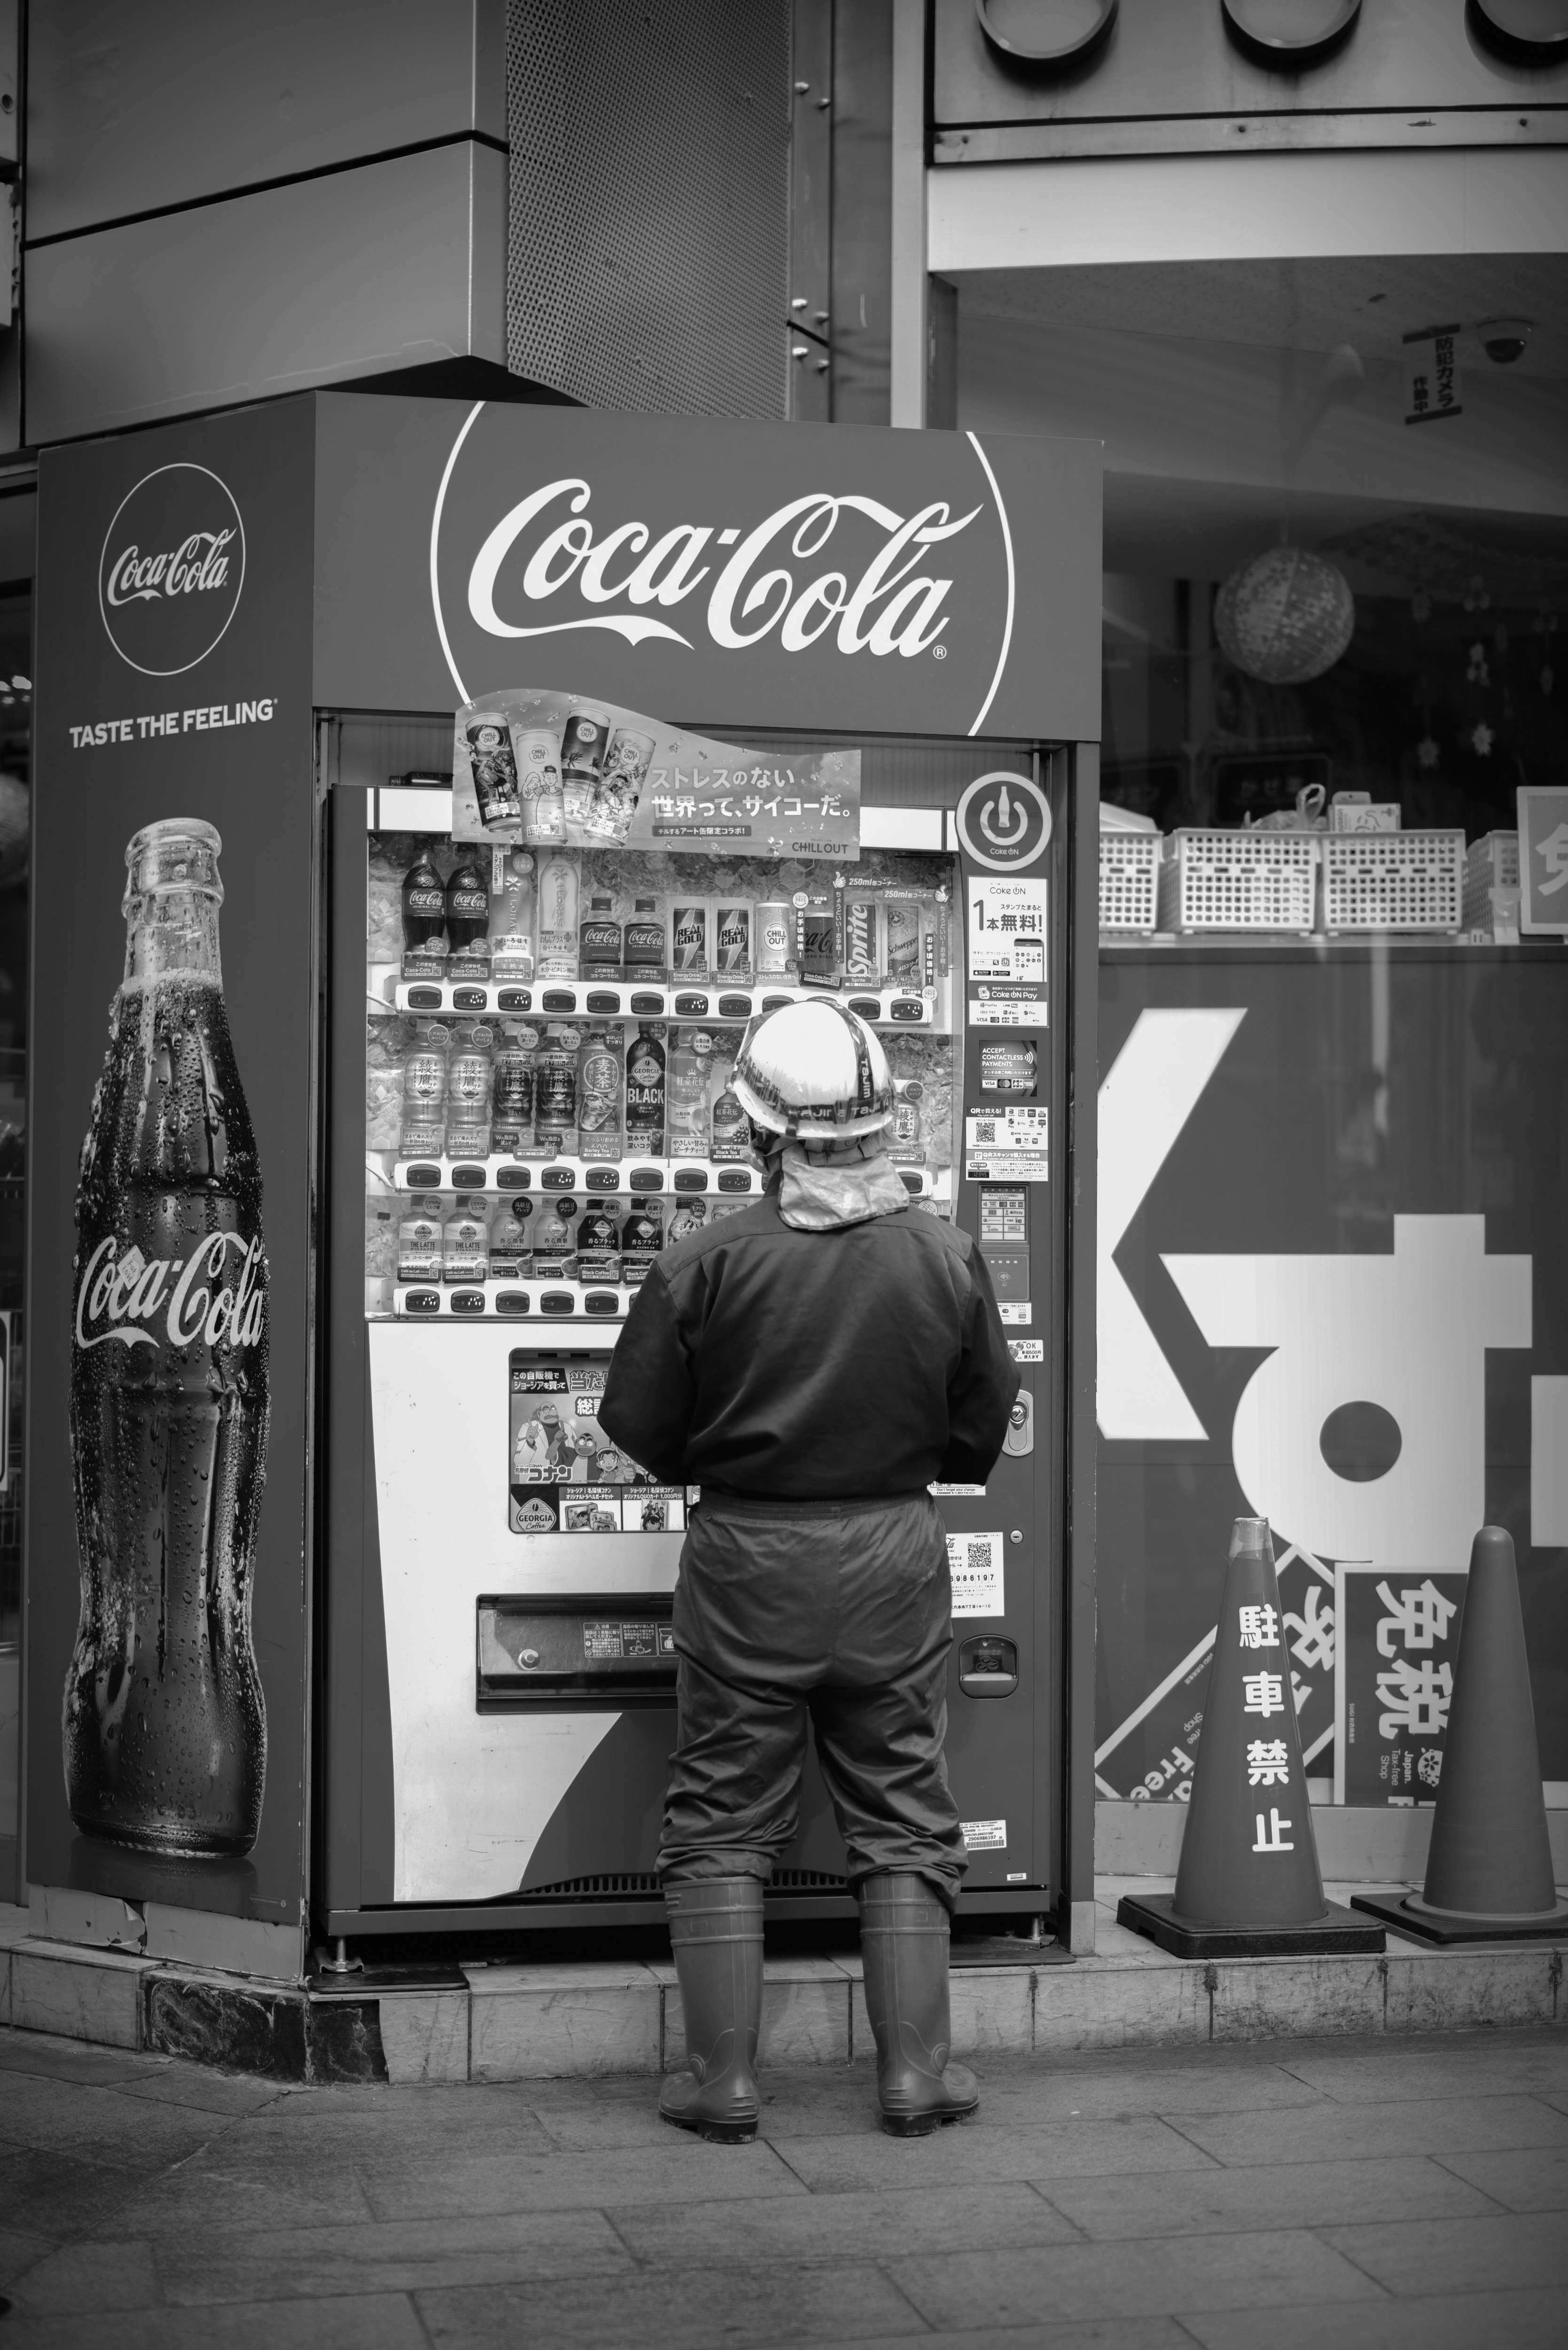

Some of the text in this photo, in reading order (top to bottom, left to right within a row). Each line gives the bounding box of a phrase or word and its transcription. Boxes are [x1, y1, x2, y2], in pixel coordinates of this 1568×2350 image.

[108, 527, 237, 606] Coca-Cola
[468, 478, 983, 658] Coca-Cola
[70, 700, 273, 749] TASTE THE FEELING
[624, 748, 640, 758] CHILL
[651, 767, 794, 789] ストレスのない
[652, 794, 850, 818] 世界って、サイコーだ。
[410, 891, 443, 906] Coca-Cola
[454, 893, 486, 907] Coca-Cola
[973, 900, 1042, 932] 1本無料!
[585, 929, 620, 945] Coca-Cola
[629, 930, 663, 946] Coca-Cola
[678, 924, 701, 938] REAL
[678, 933, 702, 946] GOLD
[722, 925, 745, 938] REAL
[722, 934, 745, 947] GOLD
[847, 905, 868, 974] Sprite
[888, 936, 919, 956] Schweppes
[418, 1059, 433, 1089] 綾鷹
[462, 1061, 478, 1090] 綾鷹
[511, 1070, 521, 1092] 綾鷹
[554, 1070, 564, 1093] 綾鷹
[596, 1058, 610, 1088] 麦茶
[676, 1076, 704, 1086] 紅茶花伝
[627, 1088, 664, 1104] BLACK
[897, 1110, 910, 1133] 綾鷹
[76, 1231, 265, 1348] Coca-Cola
[513, 1371, 559, 1379] この自販機で
[514, 1381, 566, 1390] ジョージアを買って
[527, 1465, 572, 1482] コナン
[1375, 1579, 1457, 1740] 免税
[1239, 1604, 1295, 1852] 駐車禁止
[1131, 1746, 1195, 1799] Free
[1378, 1755, 1390, 1779] Shop
[1390, 1748, 1401, 1786] Tax-free
[1402, 1750, 1414, 1784] Japan.
